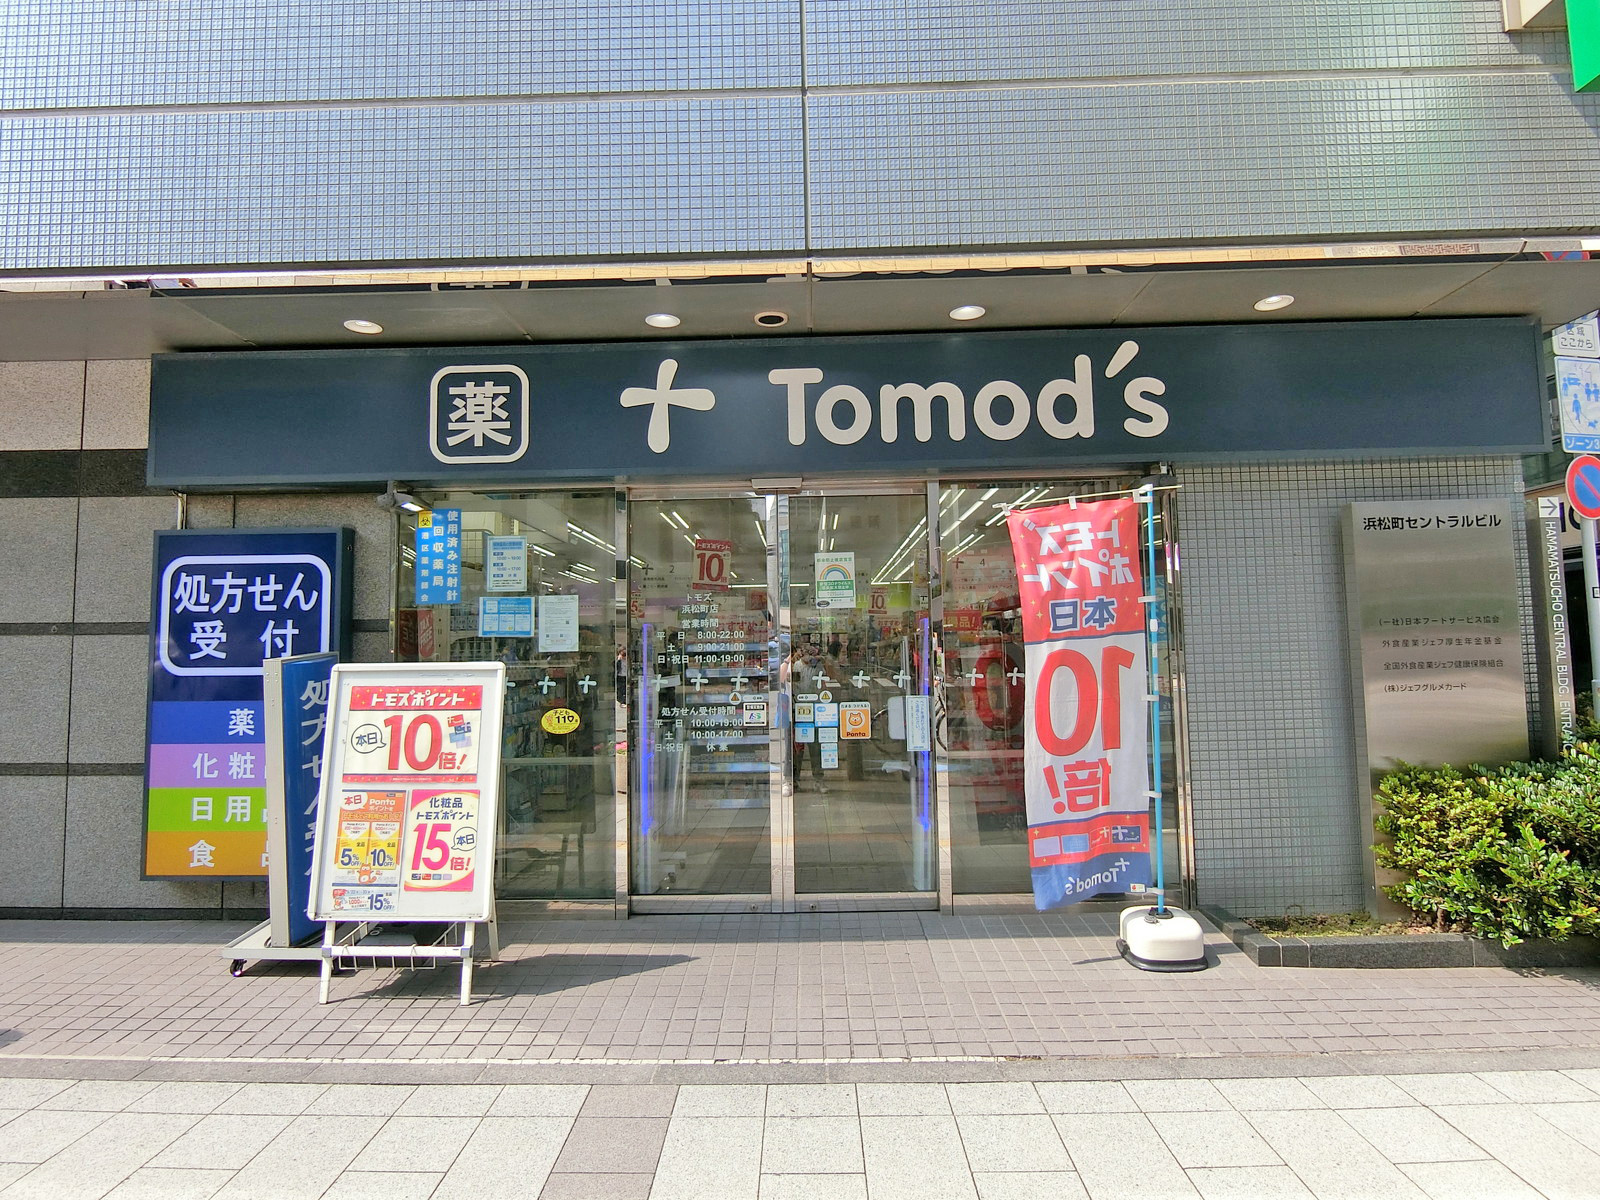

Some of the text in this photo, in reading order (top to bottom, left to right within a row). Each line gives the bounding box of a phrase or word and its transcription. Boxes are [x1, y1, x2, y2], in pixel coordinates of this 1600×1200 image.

[1561, 337, 1593, 349] ここから
[768, 340, 1169, 446] Tomod's
[446, 381, 512, 447] 薬
[1363, 514, 1502, 531] 浜松町セントラルビル
[432, 526, 444, 587] 回収薬局
[446, 511, 459, 601] 使用済み注射針
[696, 552, 725, 582] 10
[1545, 521, 1564, 611] HAMAMATSUCHO
[173, 571, 320, 615] 処方せん
[686, 593, 713, 602] トモズ
[681, 604, 719, 614] 浜松町店
[681, 619, 719, 629] 営業時間
[190, 619, 300, 660] 受付
[697, 631, 745, 640] 8:00-22:00
[1552, 614, 1568, 663] CENTRAL
[697, 643, 745, 651] 9:00-21:00
[693, 655, 745, 664] 11:00-19:00
[1384, 682, 1467, 693] (株)ジェフグルメカード
[1557, 665, 1570, 697] BLDG.
[371, 689, 466, 707] トモズポイント
[661, 706, 736, 717] 処方せん受付時間
[228, 708, 255, 736] 薬
[690, 718, 743, 727] 10:00-19:00
[355, 732, 378, 747] 本日
[383, 713, 444, 771] 10
[690, 730, 744, 739] 10:00-17:00
[706, 743, 729, 752] 休業
[192, 752, 267, 780] 化粧
[438, 751, 468, 770] 倍!
[344, 794, 362, 806] 本日
[369, 798, 396, 806] Ponta
[429, 797, 463, 809] 化粧品
[190, 795, 267, 823] 日用
[416, 809, 474, 820] トモズポイント
[411, 823, 452, 871] 15
[456, 833, 475, 846] 本日
[449, 856, 471, 871] 倍!
